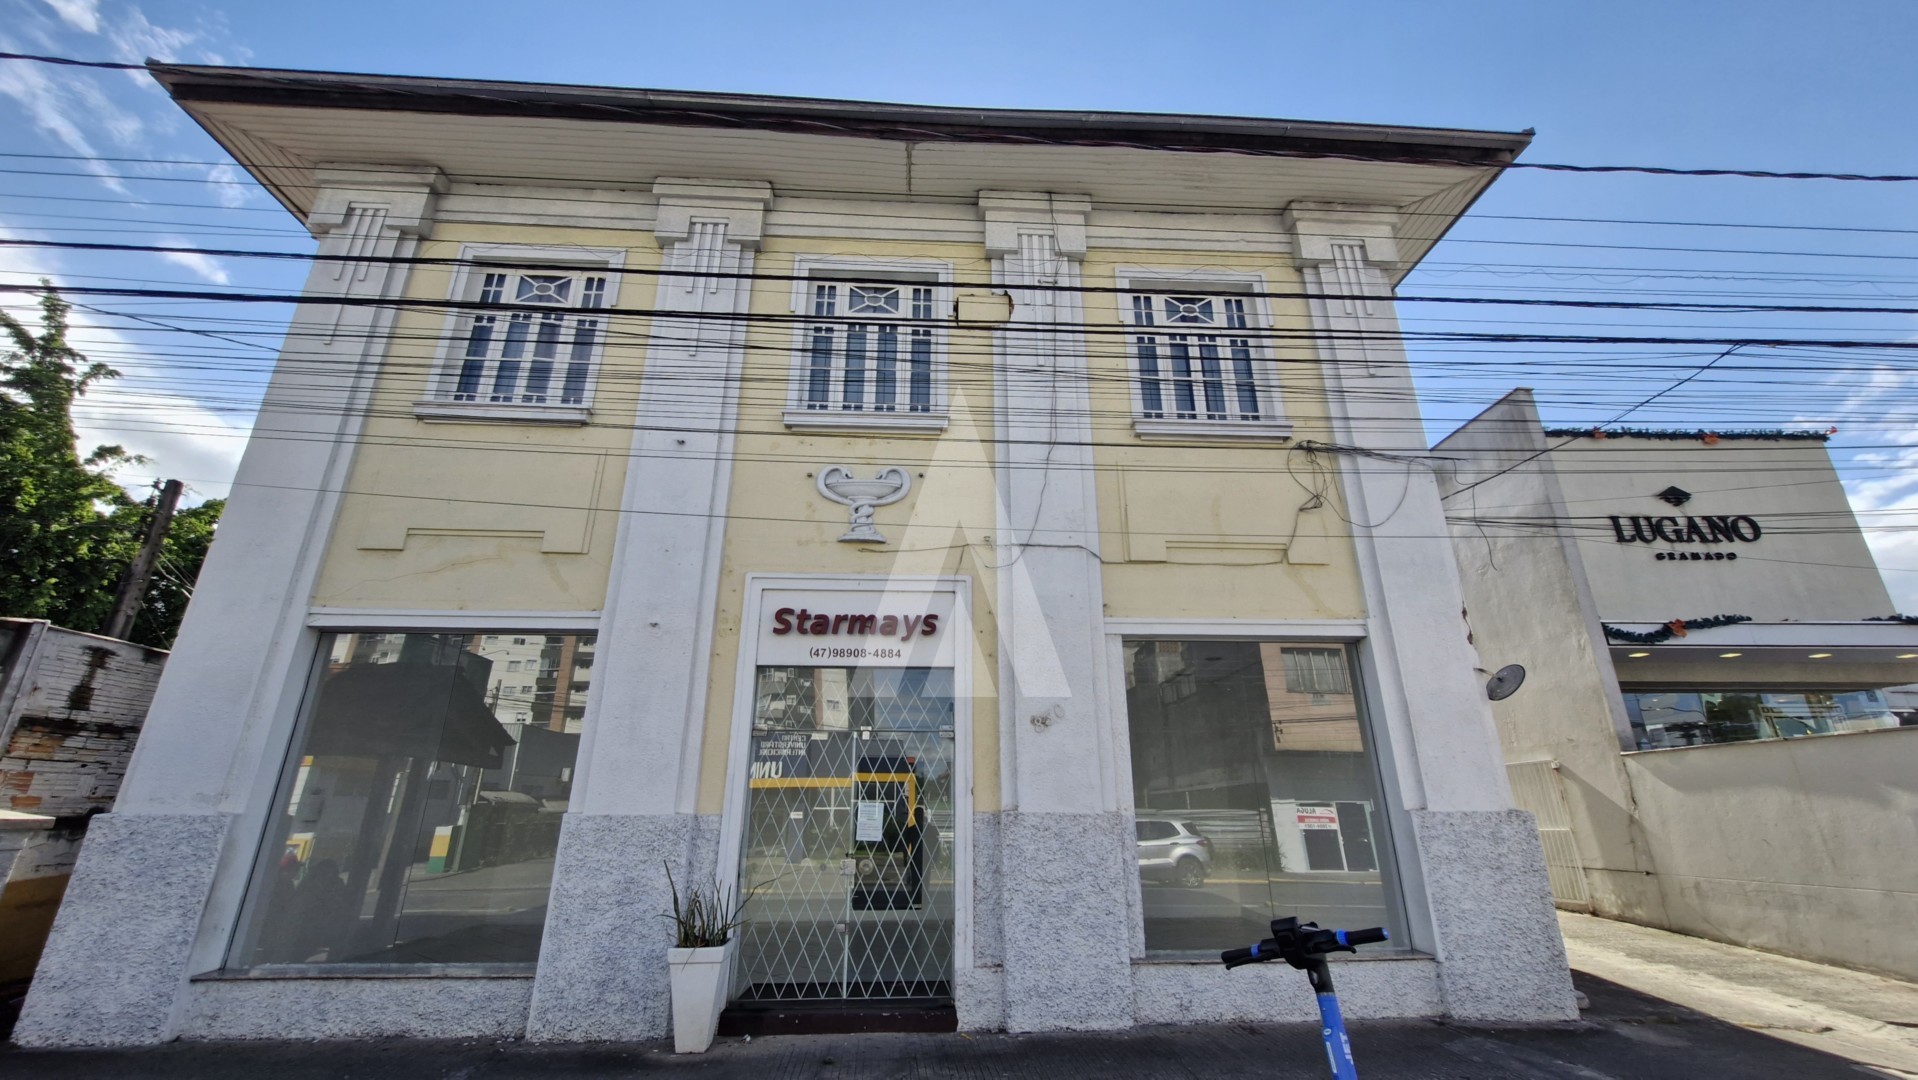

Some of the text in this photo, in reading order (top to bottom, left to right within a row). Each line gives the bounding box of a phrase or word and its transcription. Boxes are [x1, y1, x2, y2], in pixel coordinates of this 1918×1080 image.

[1608, 515, 1762, 544] LUGANO
[1655, 552, 1738, 561] GRAMADO
[772, 607, 939, 642] Starmays
[809, 646, 902, 660] (47)98908-4884
